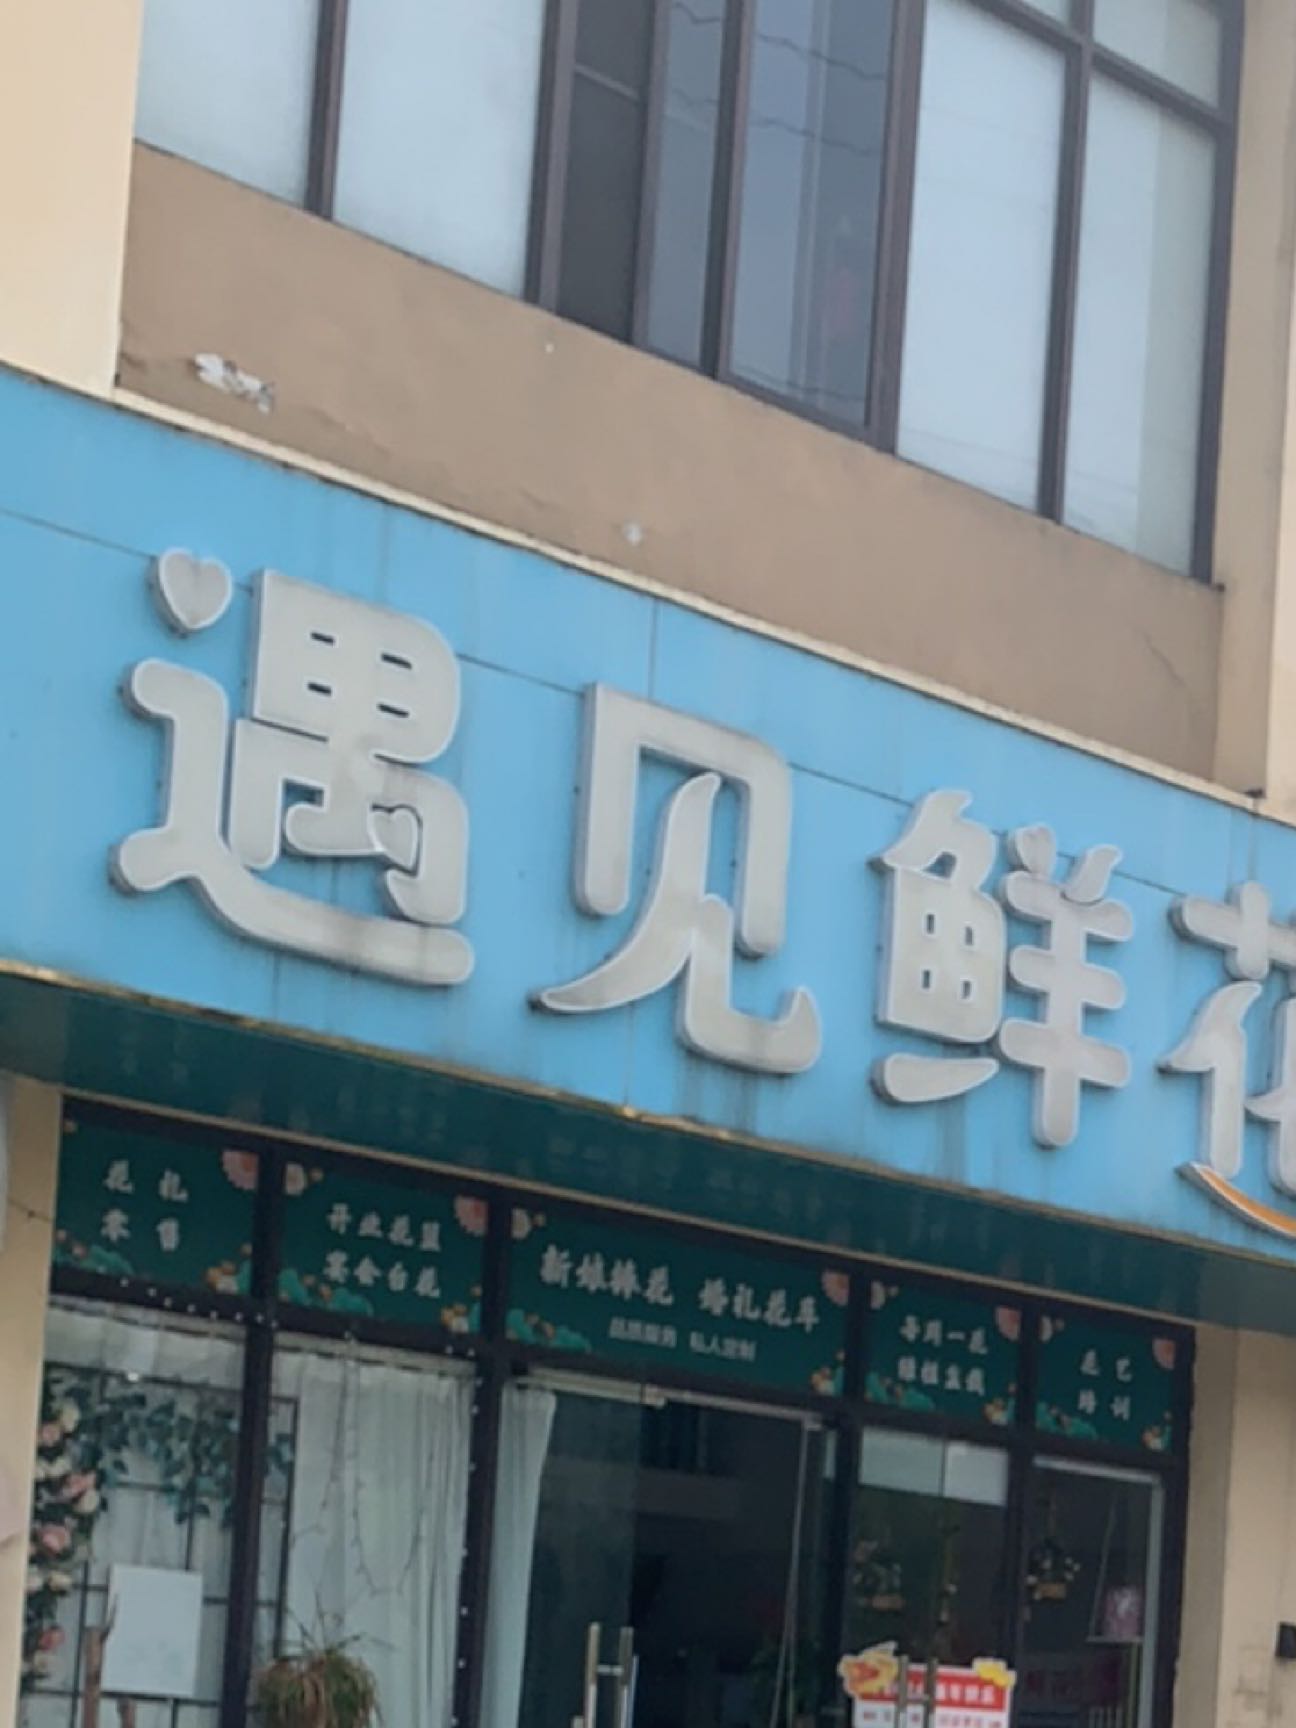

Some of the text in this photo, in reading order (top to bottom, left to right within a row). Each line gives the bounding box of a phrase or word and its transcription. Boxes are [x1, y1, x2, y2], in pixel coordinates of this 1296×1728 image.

[539, 1243, 821, 1334] 新娘捧花 婚礼花车
